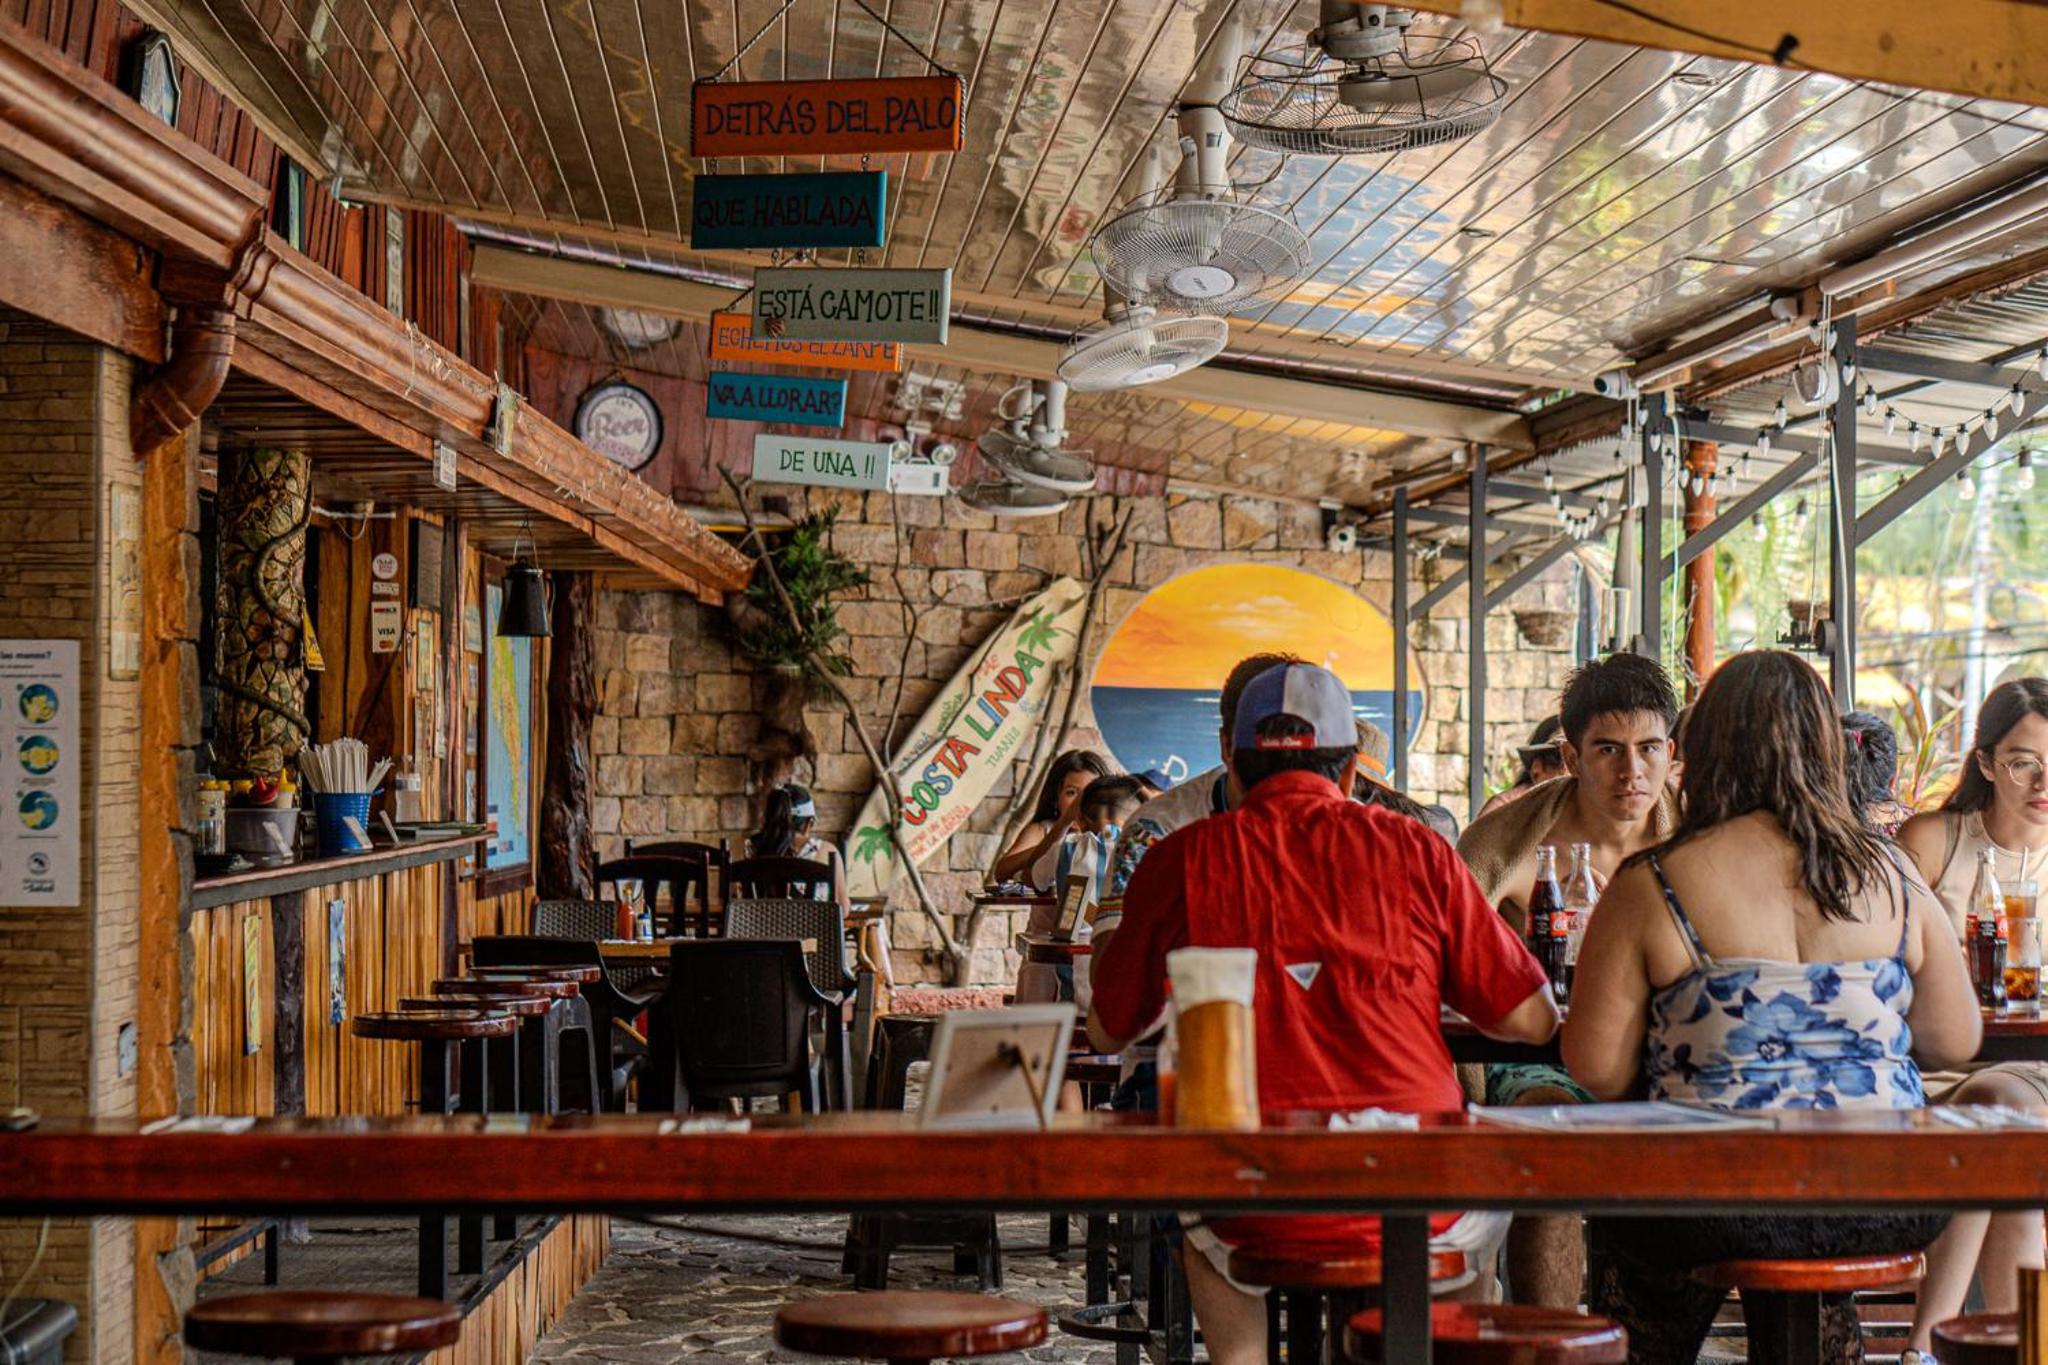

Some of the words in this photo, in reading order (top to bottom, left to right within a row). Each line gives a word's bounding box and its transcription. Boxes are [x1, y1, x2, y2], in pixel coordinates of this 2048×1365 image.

[706, 95, 816, 136] DETRÁS
[827, 99, 880, 135] DEL
[885, 96, 956, 133] PALO
[697, 199, 745, 229] QUE
[752, 195, 875, 228] HABLADA
[758, 284, 815, 321] ESTÁ
[780, 448, 805, 472] DE
[814, 450, 857, 477] UNA
[377, 628, 397, 636] VISA
[902, 734, 980, 826] COSTA
[965, 650, 1045, 741] LINDA
